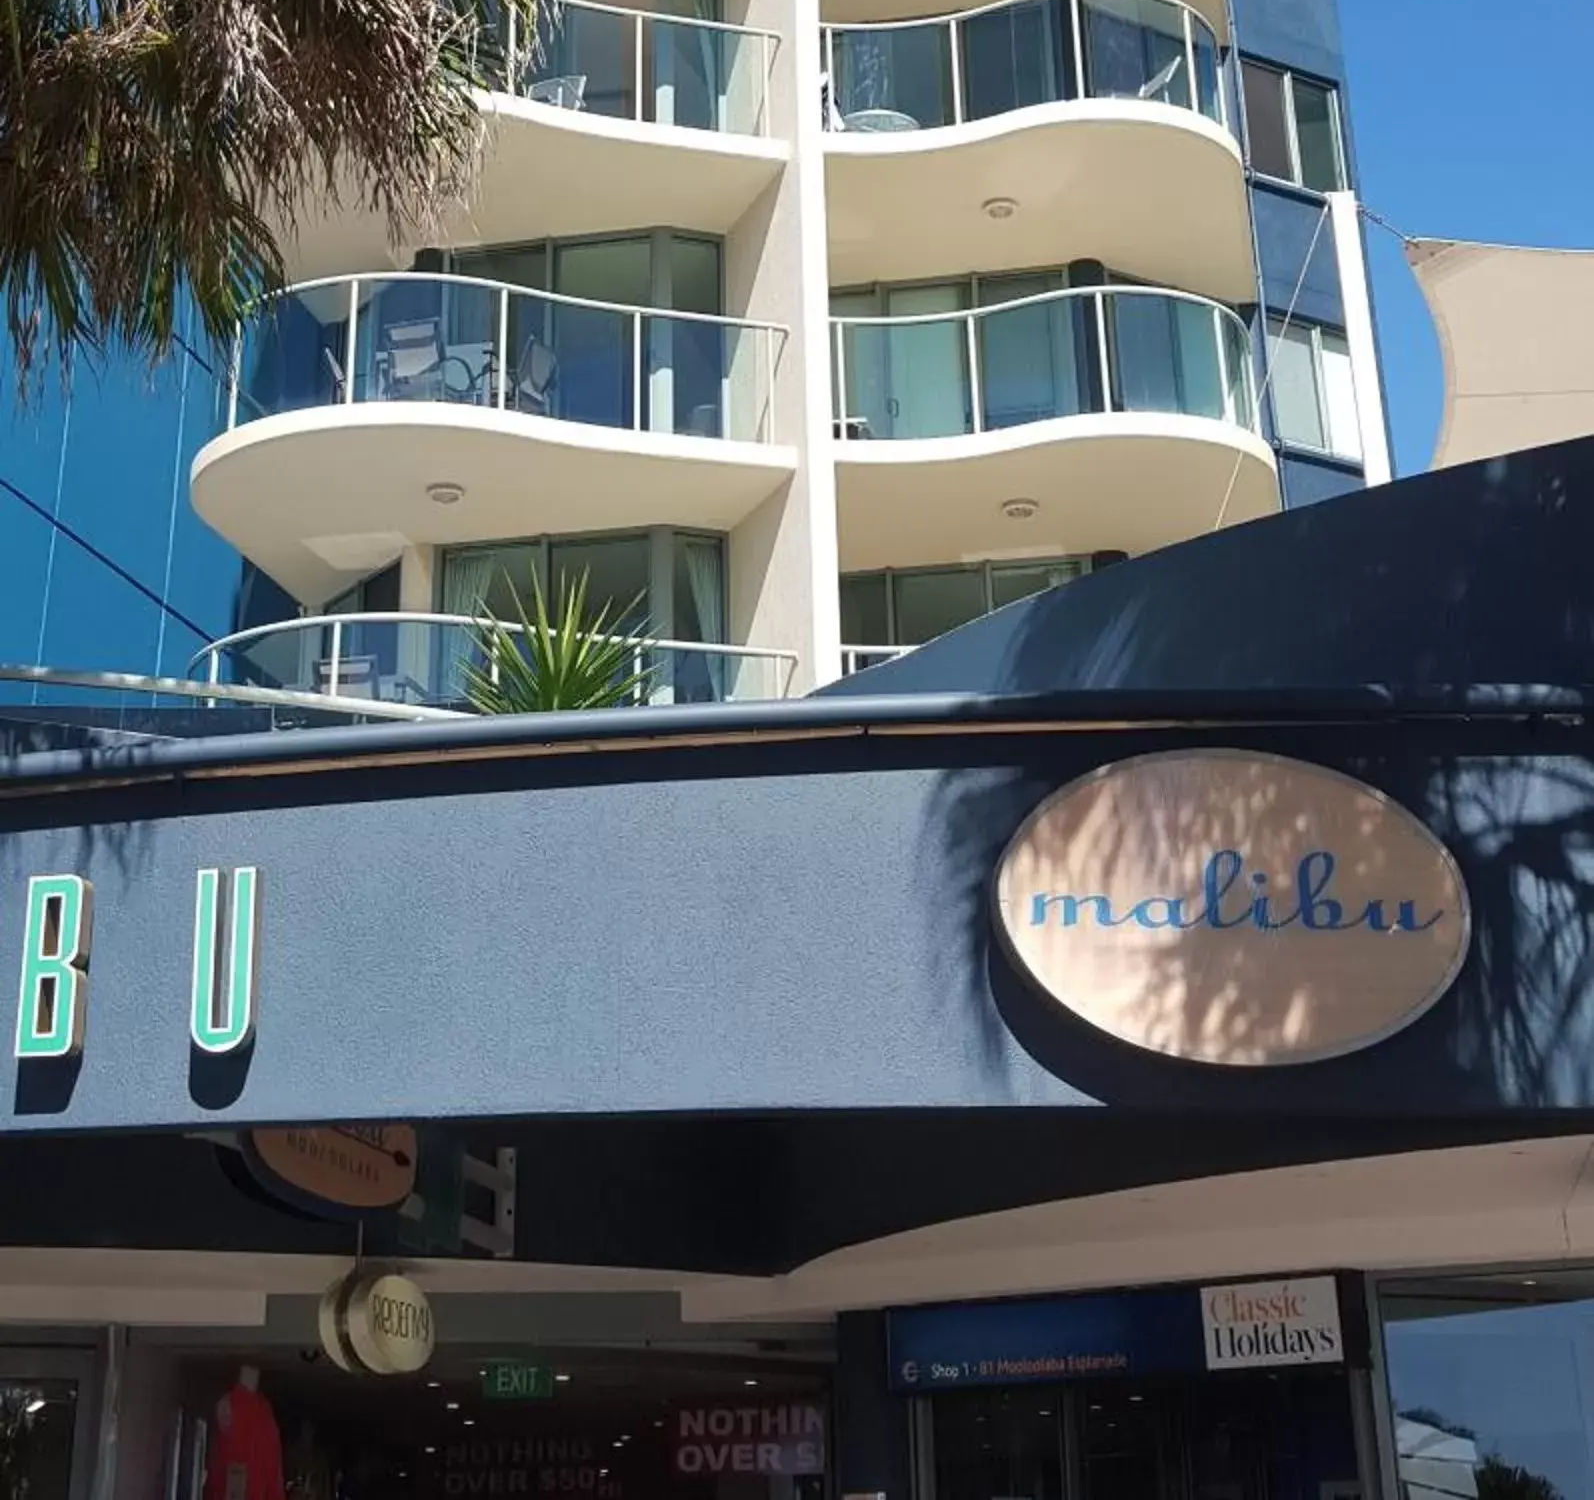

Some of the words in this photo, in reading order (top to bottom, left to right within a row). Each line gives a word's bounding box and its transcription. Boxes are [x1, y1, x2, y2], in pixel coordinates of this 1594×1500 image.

[1030, 849, 1444, 932] malibu
[1209, 1283, 1307, 1324] Classic
[1212, 1321, 1336, 1361] Holidays
[497, 1367, 538, 1392] EXIT
[931, 1361, 960, 1381] Shop
[963, 1361, 971, 1377] 1
[445, 1437, 593, 1464] NOTHING
[677, 1442, 783, 1473] OVER
[444, 1468, 528, 1495] OVER
